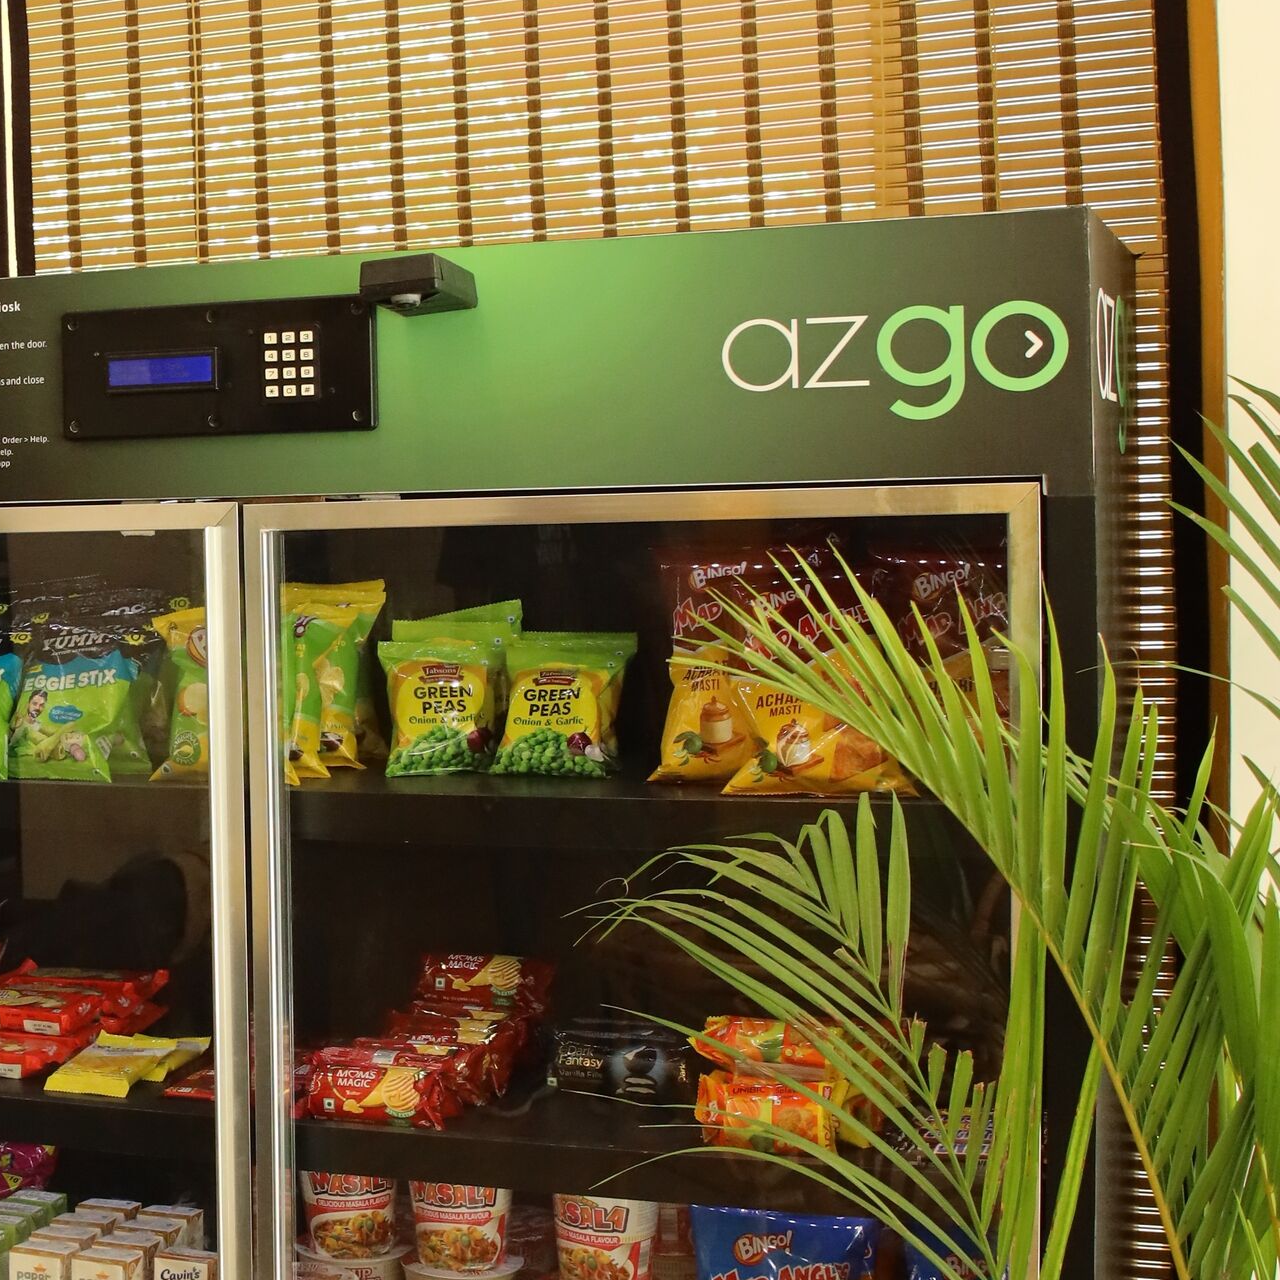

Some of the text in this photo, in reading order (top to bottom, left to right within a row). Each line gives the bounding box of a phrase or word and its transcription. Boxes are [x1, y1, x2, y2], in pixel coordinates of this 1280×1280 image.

[11, 340, 25, 350] the
[27, 339, 47, 349] door.
[721, 299, 1070, 421] azgo
[6, 376, 21, 385] and
[23, 375, 45, 385] close
[2, 436, 22, 444] Order
[30, 435, 50, 444] Help.
[915, 563, 971, 600] BINGO!
[78, 669, 117, 687] STIX
[691, 680, 720, 692] MASTI
[414, 685, 473, 700] GREEN
[524, 687, 580, 701] GREEN
[422, 700, 467, 714] PEAS
[529, 702, 571, 716] PEAS
[770, 705, 801, 717] MASTI
[409, 716, 437, 724] Onion
[513, 716, 583, 726] Onion Garlic
[559, 1055, 604, 1069] Fantasy
[337, 1078, 372, 1088] MAGIC
[346, 1200, 369, 1209] MASALA
[440, 1211, 490, 1220] MASALA FLAVOUR
[590, 1236, 618, 1244] FLAVOUR
[738, 1230, 793, 1260] BINGO!
[17, 1271, 51, 1280] paper
[160, 1268, 200, 1280] Cavin's
